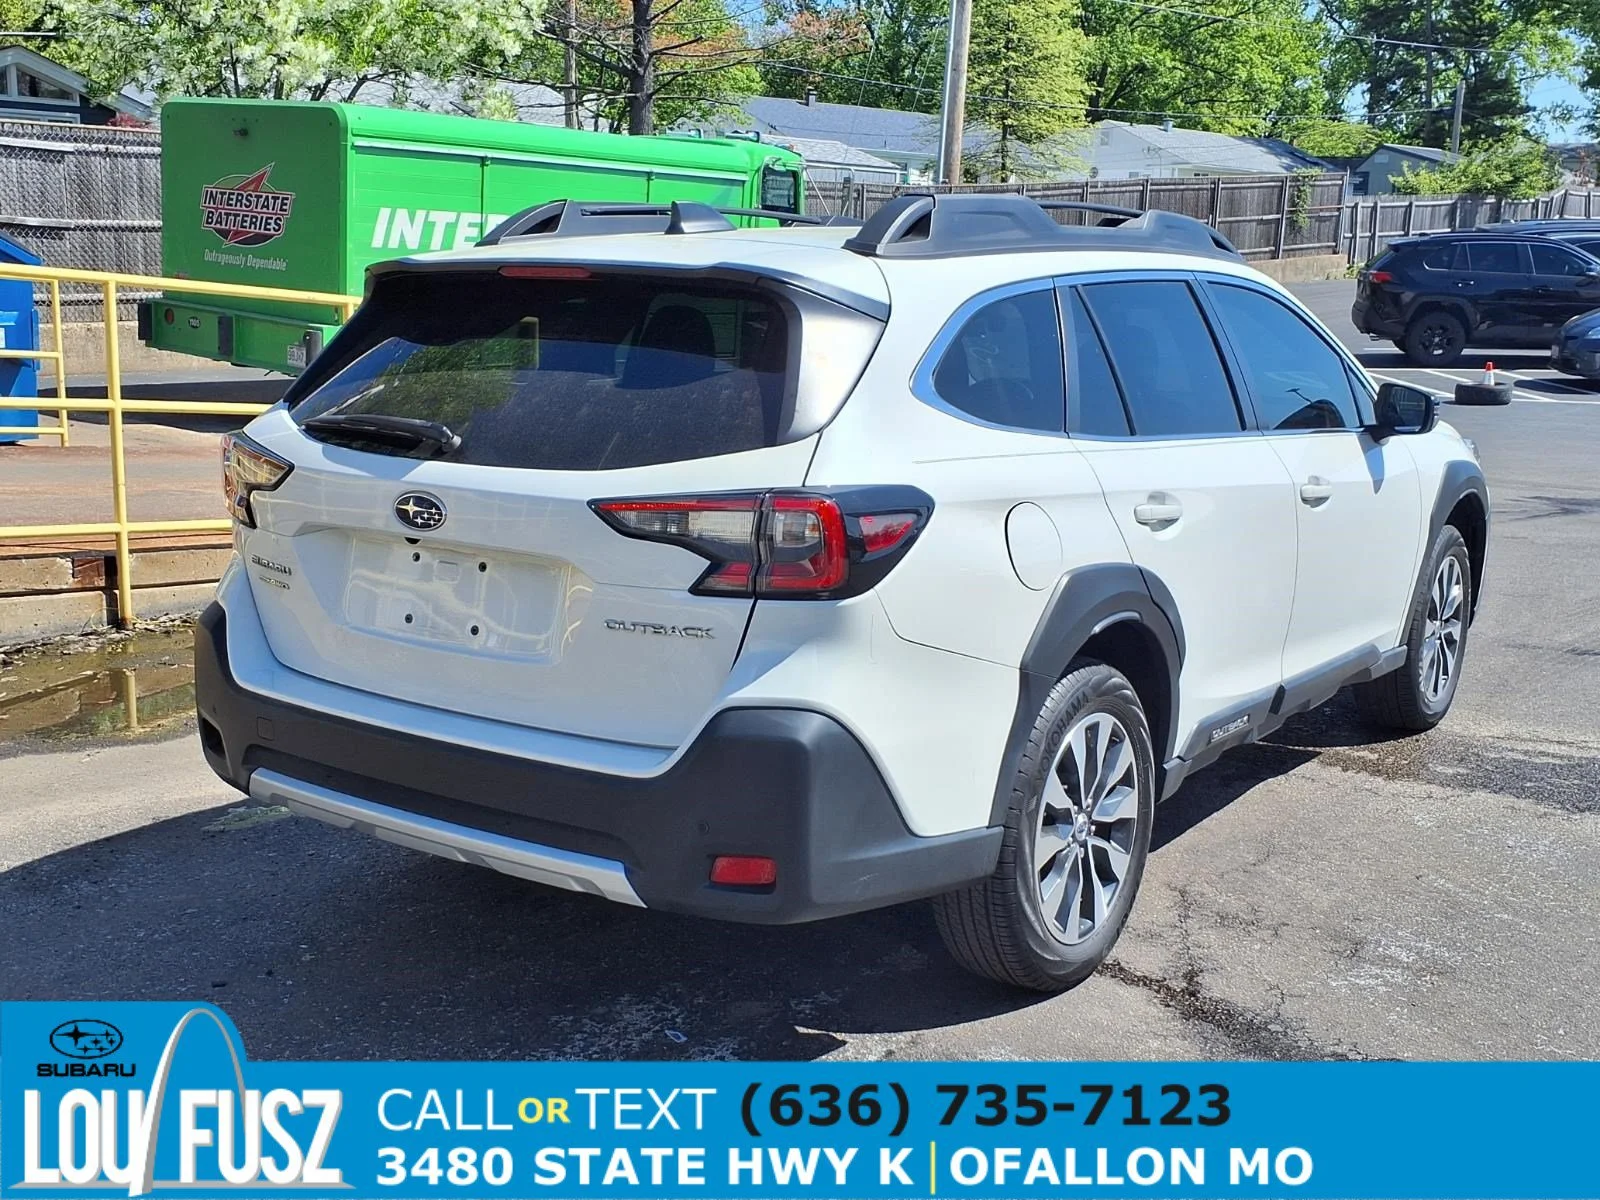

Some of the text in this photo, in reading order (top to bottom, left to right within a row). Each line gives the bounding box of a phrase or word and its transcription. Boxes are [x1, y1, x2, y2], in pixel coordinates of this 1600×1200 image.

[203, 188, 291, 213] INTERSTATE
[205, 210, 283, 234] BATTERIES
[204, 248, 287, 271] Outrageously Dependable
[251, 553, 292, 576] SUBARU
[604, 619, 716, 640] OUTBACK
[1036, 690, 1090, 782] YOKOHAMA
[1212, 715, 1249, 738] OUTBACK
